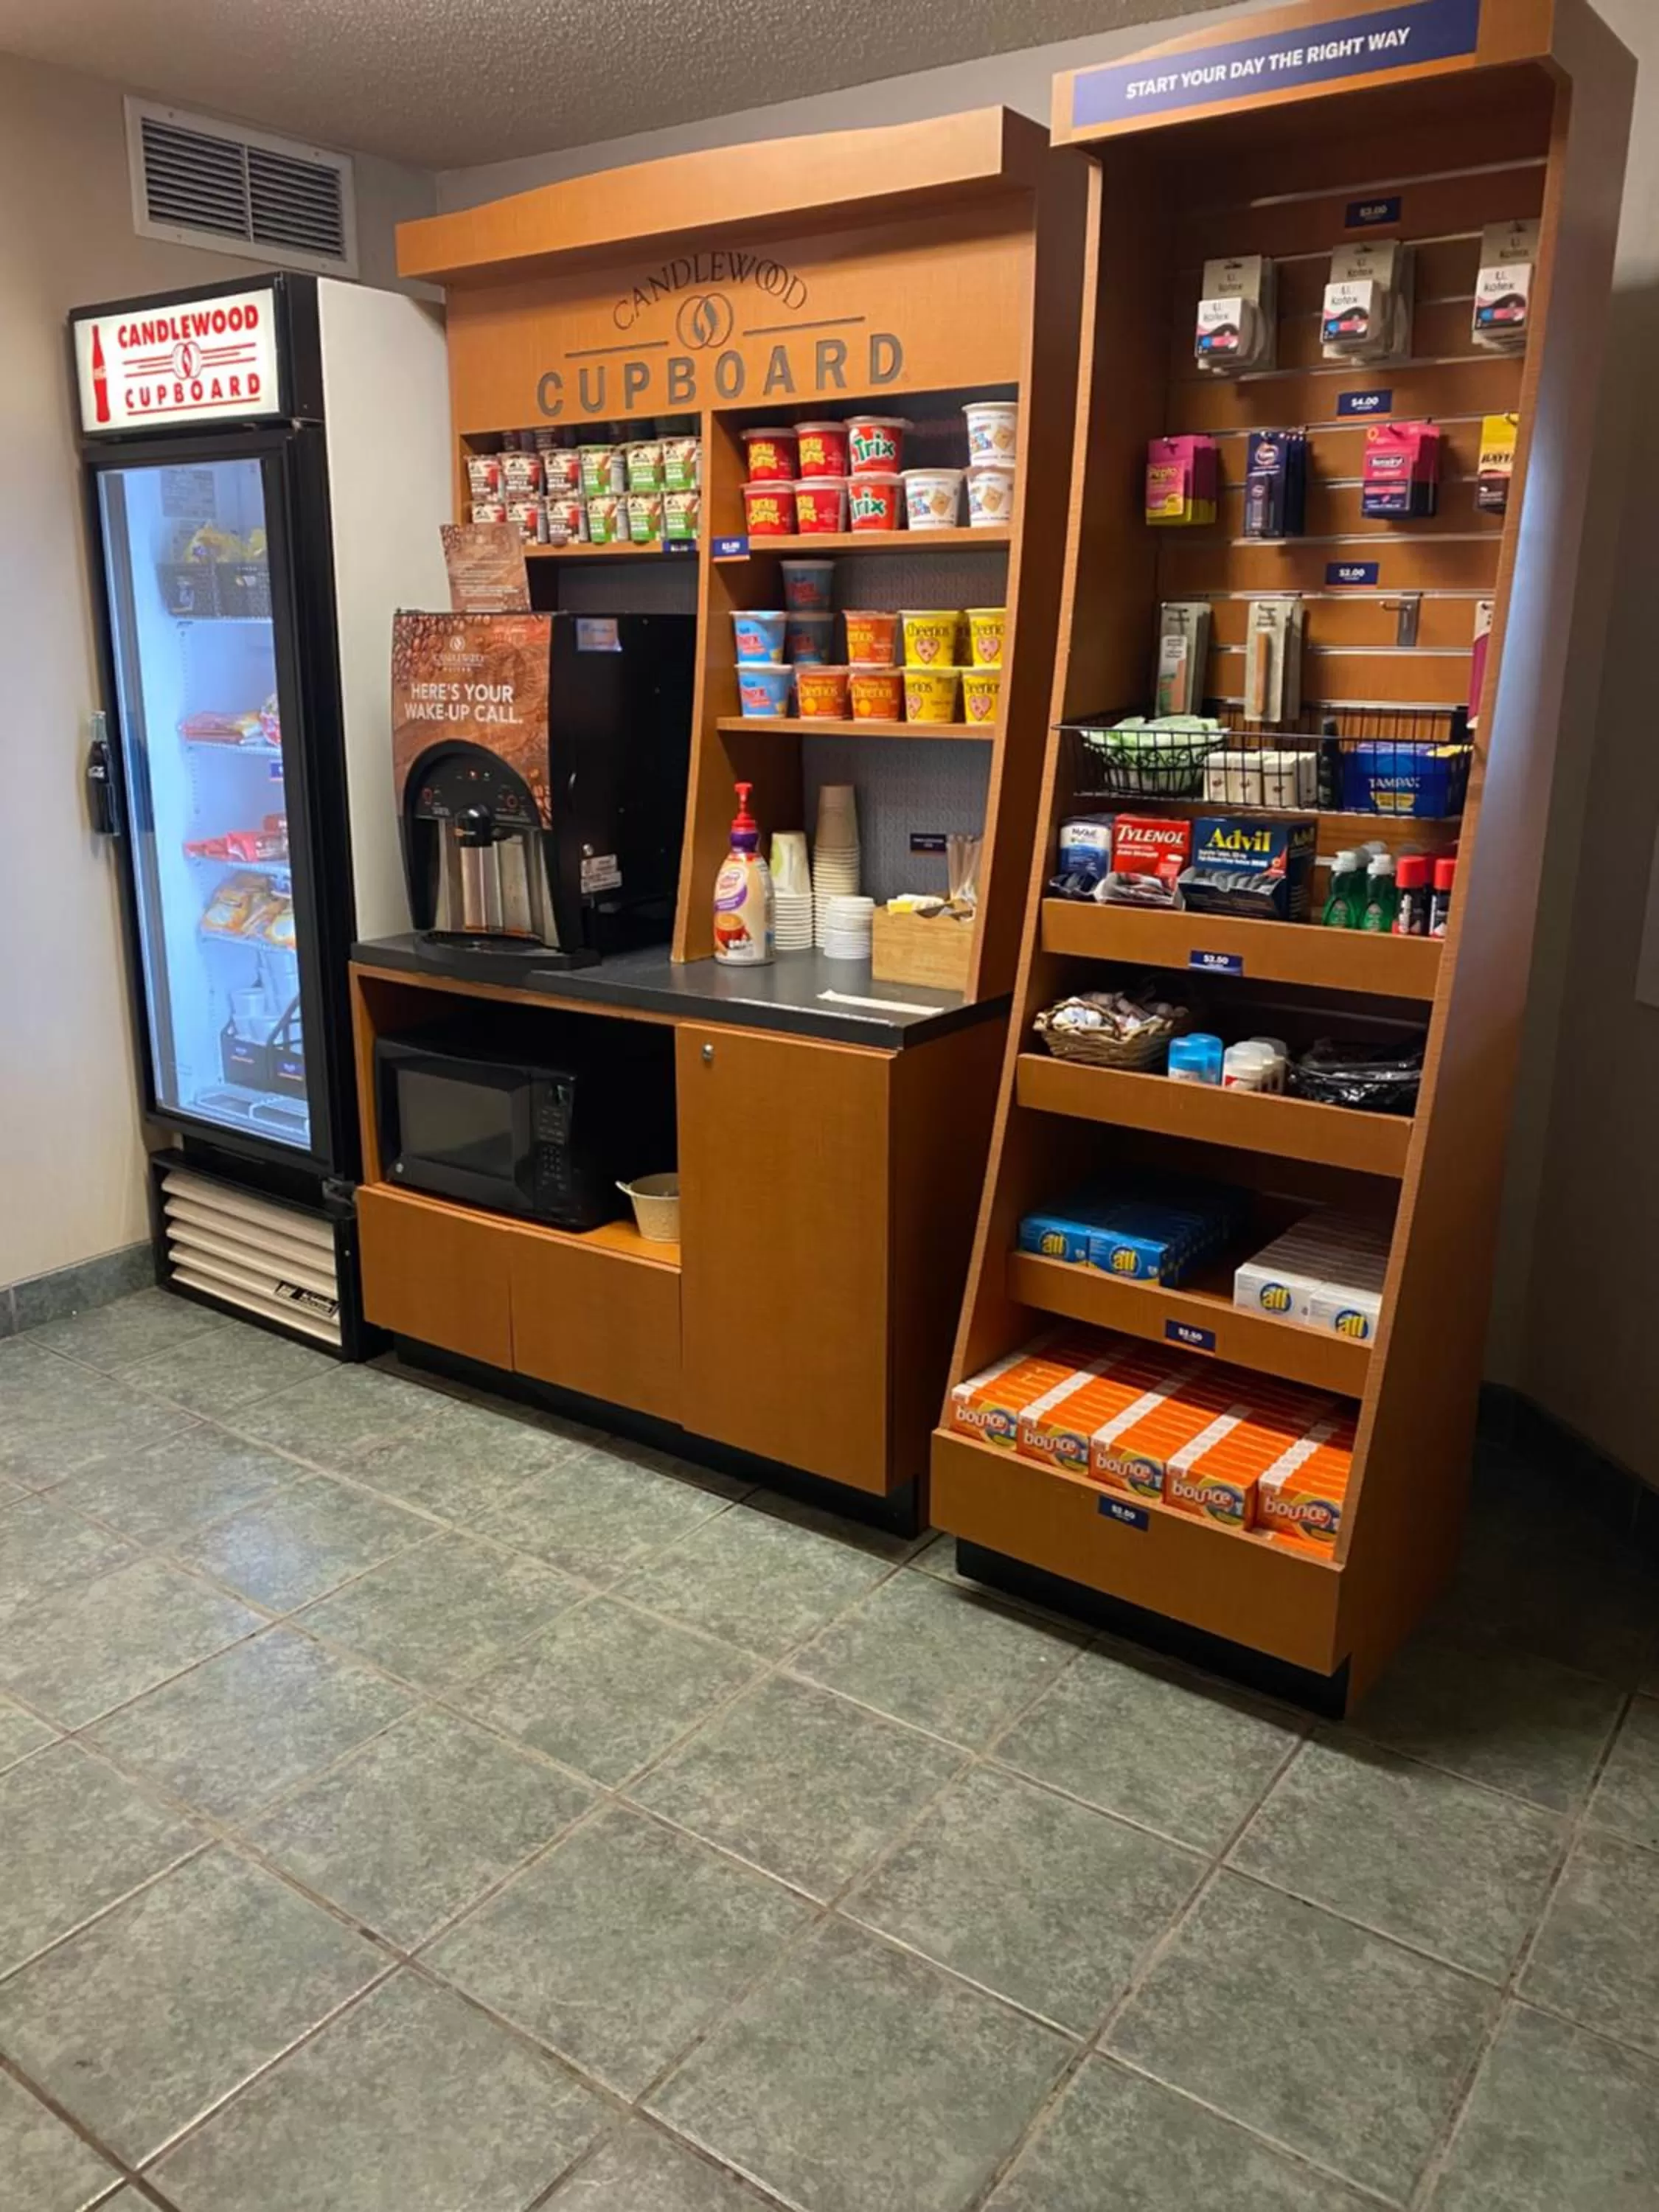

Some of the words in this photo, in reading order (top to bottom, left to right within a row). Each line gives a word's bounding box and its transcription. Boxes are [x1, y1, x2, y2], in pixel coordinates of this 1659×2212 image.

[1126, 74, 1178, 100] START
[1181, 64, 1226, 88] YOUR
[1231, 57, 1265, 77] DAY
[1269, 50, 1302, 71] THE
[1307, 38, 1363, 63] RIGHT
[1368, 27, 1411, 51] WAY
[613, 251, 808, 330] CANDLEWOOD
[117, 305, 259, 348] CANDLEWOOD
[537, 333, 903, 417] CUPBOARD
[125, 372, 260, 409] CUPBOARD
[853, 430, 895, 461] Trix
[411, 683, 460, 700] HERE'S
[464, 684, 513, 703] YOUR
[404, 703, 470, 720] WAKE-UP
[474, 705, 524, 725] CALL.
[1116, 824, 1185, 844] TYLENOL
[1205, 827, 1271, 852] Advil
[1041, 1234, 1063, 1254] all
[1113, 1250, 1136, 1271] all
[1262, 1287, 1288, 1309] all
[1338, 1315, 1365, 1338] all
[956, 1405, 1006, 1427] bounce
[1024, 1428, 1077, 1451] bounce
[1096, 1453, 1151, 1478] bounce
[1172, 1480, 1232, 1506] bounce
[1265, 1498, 1329, 1524] bounce
